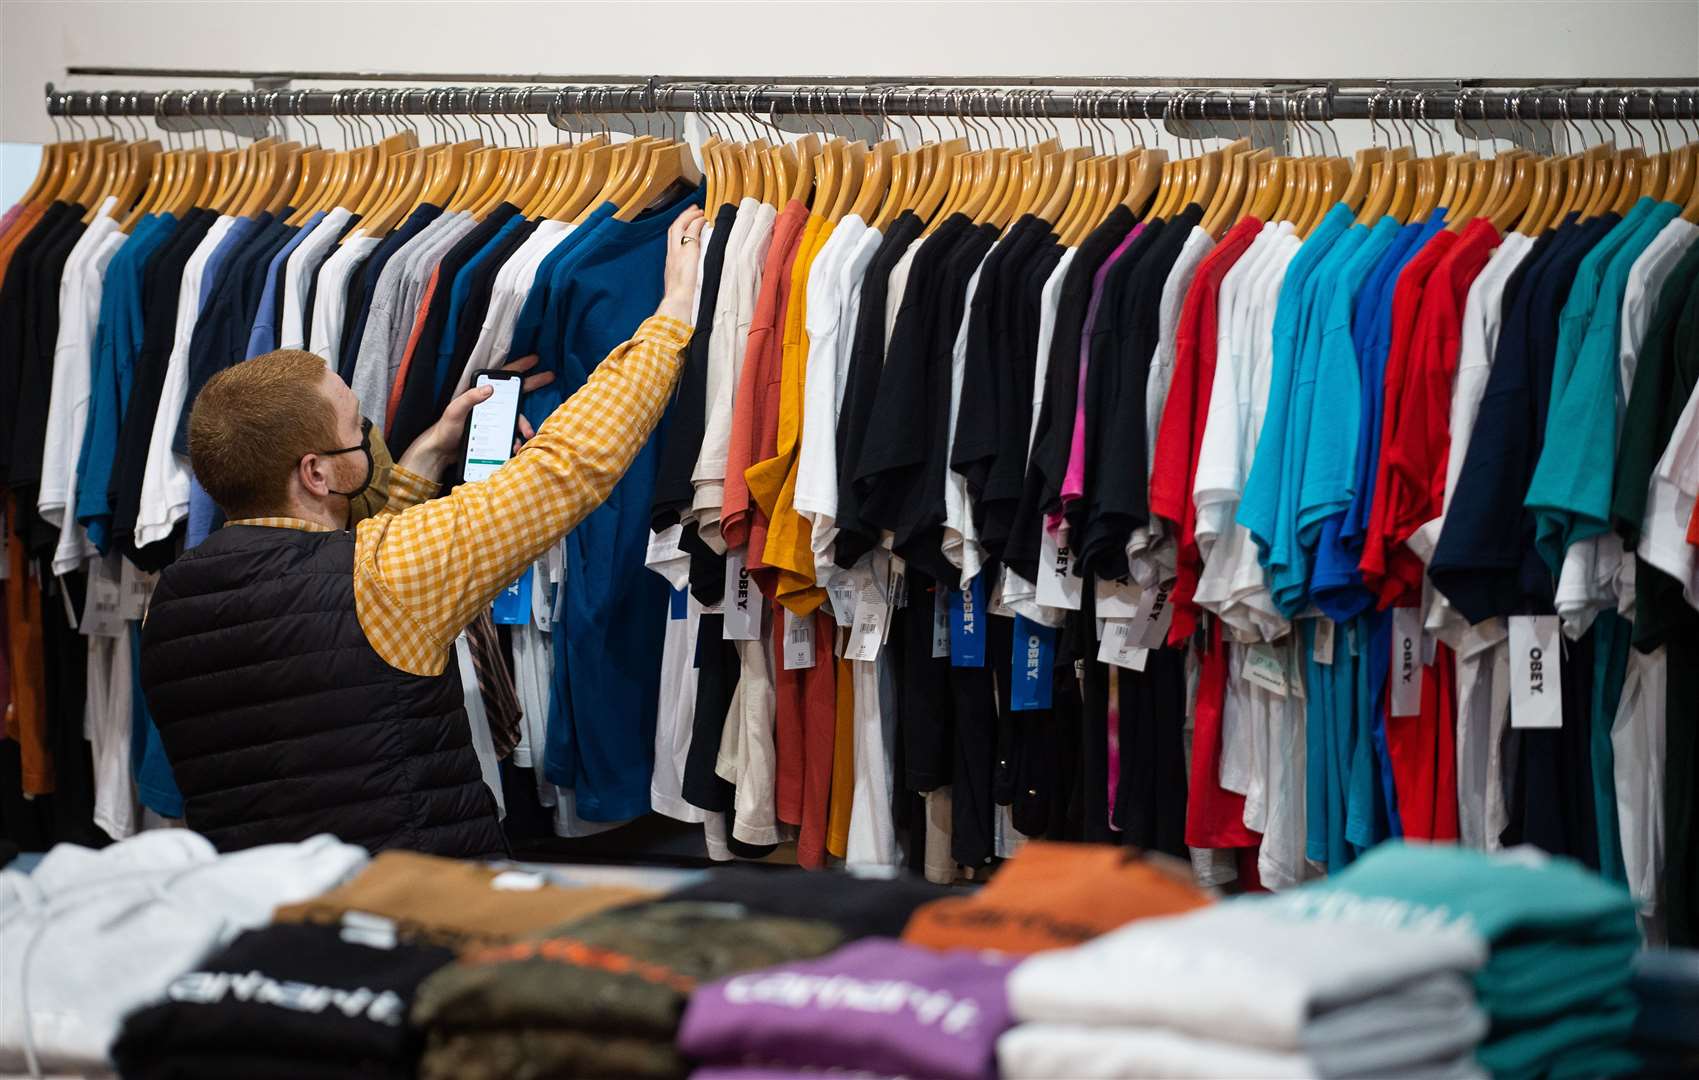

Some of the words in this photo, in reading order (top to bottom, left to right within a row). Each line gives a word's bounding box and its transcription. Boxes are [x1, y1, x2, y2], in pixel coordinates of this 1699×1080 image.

[1055, 546, 1069, 578] BEY.
[962, 590, 974, 635] OBEY.
[1027, 635, 1040, 681] OBEY.
[1402, 637, 1412, 684] OBEY.
[1529, 647, 1544, 696] OBEY.
